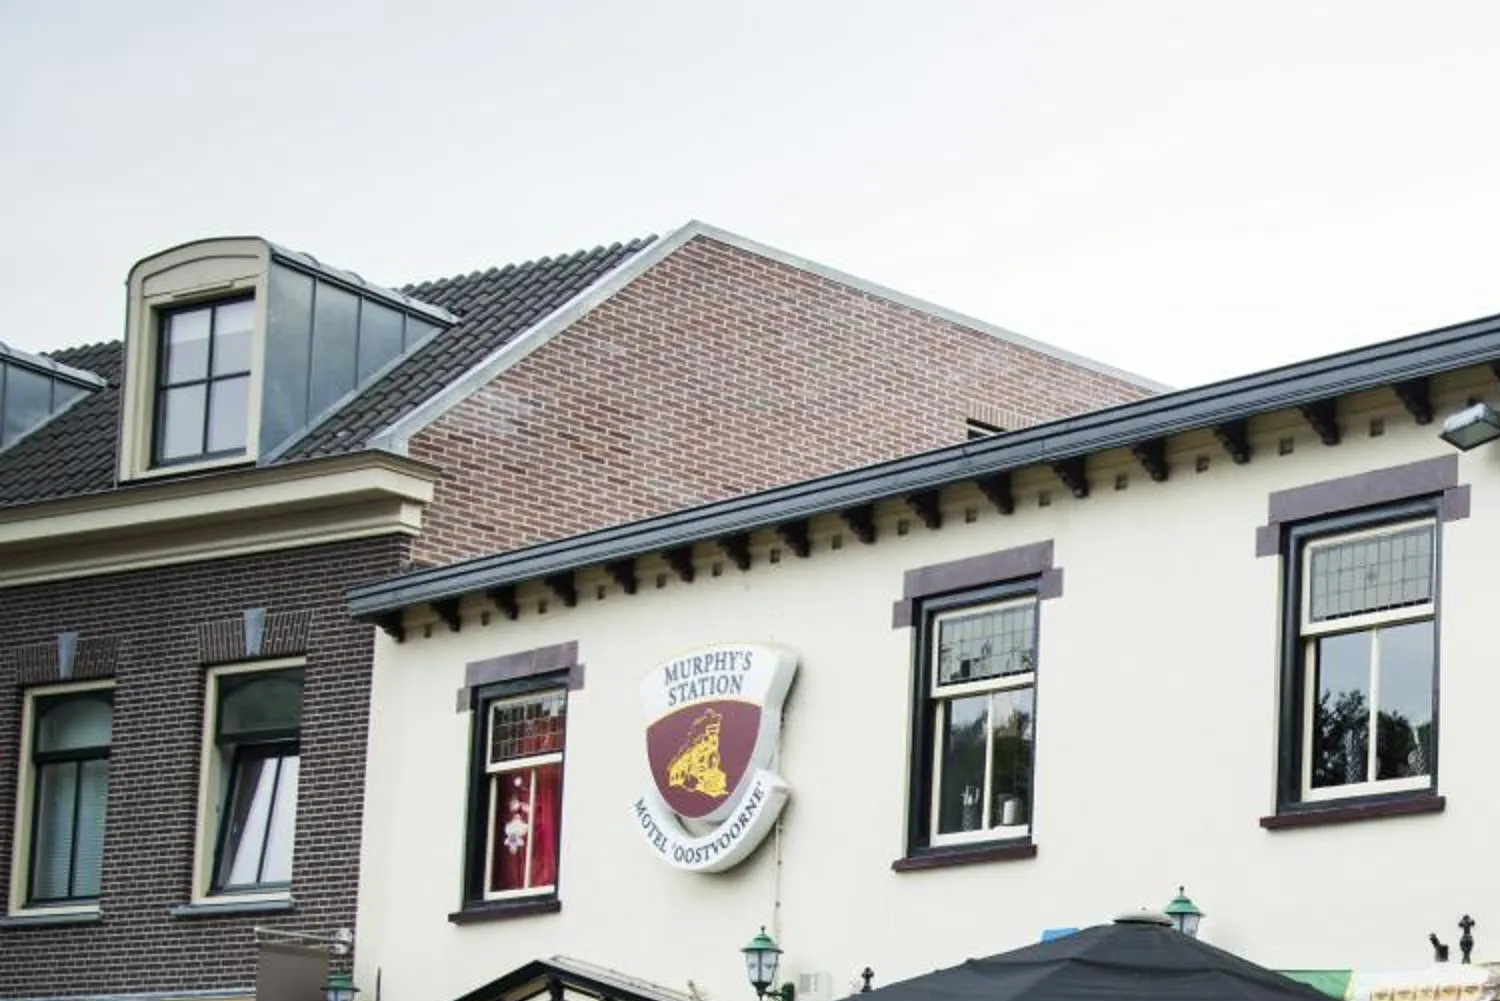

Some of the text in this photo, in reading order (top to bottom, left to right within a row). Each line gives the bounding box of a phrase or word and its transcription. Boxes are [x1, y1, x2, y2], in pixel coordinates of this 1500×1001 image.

[664, 651, 753, 685] MURPHY'S
[668, 675, 744, 706] STATION
[634, 797, 669, 854] MOTEL
